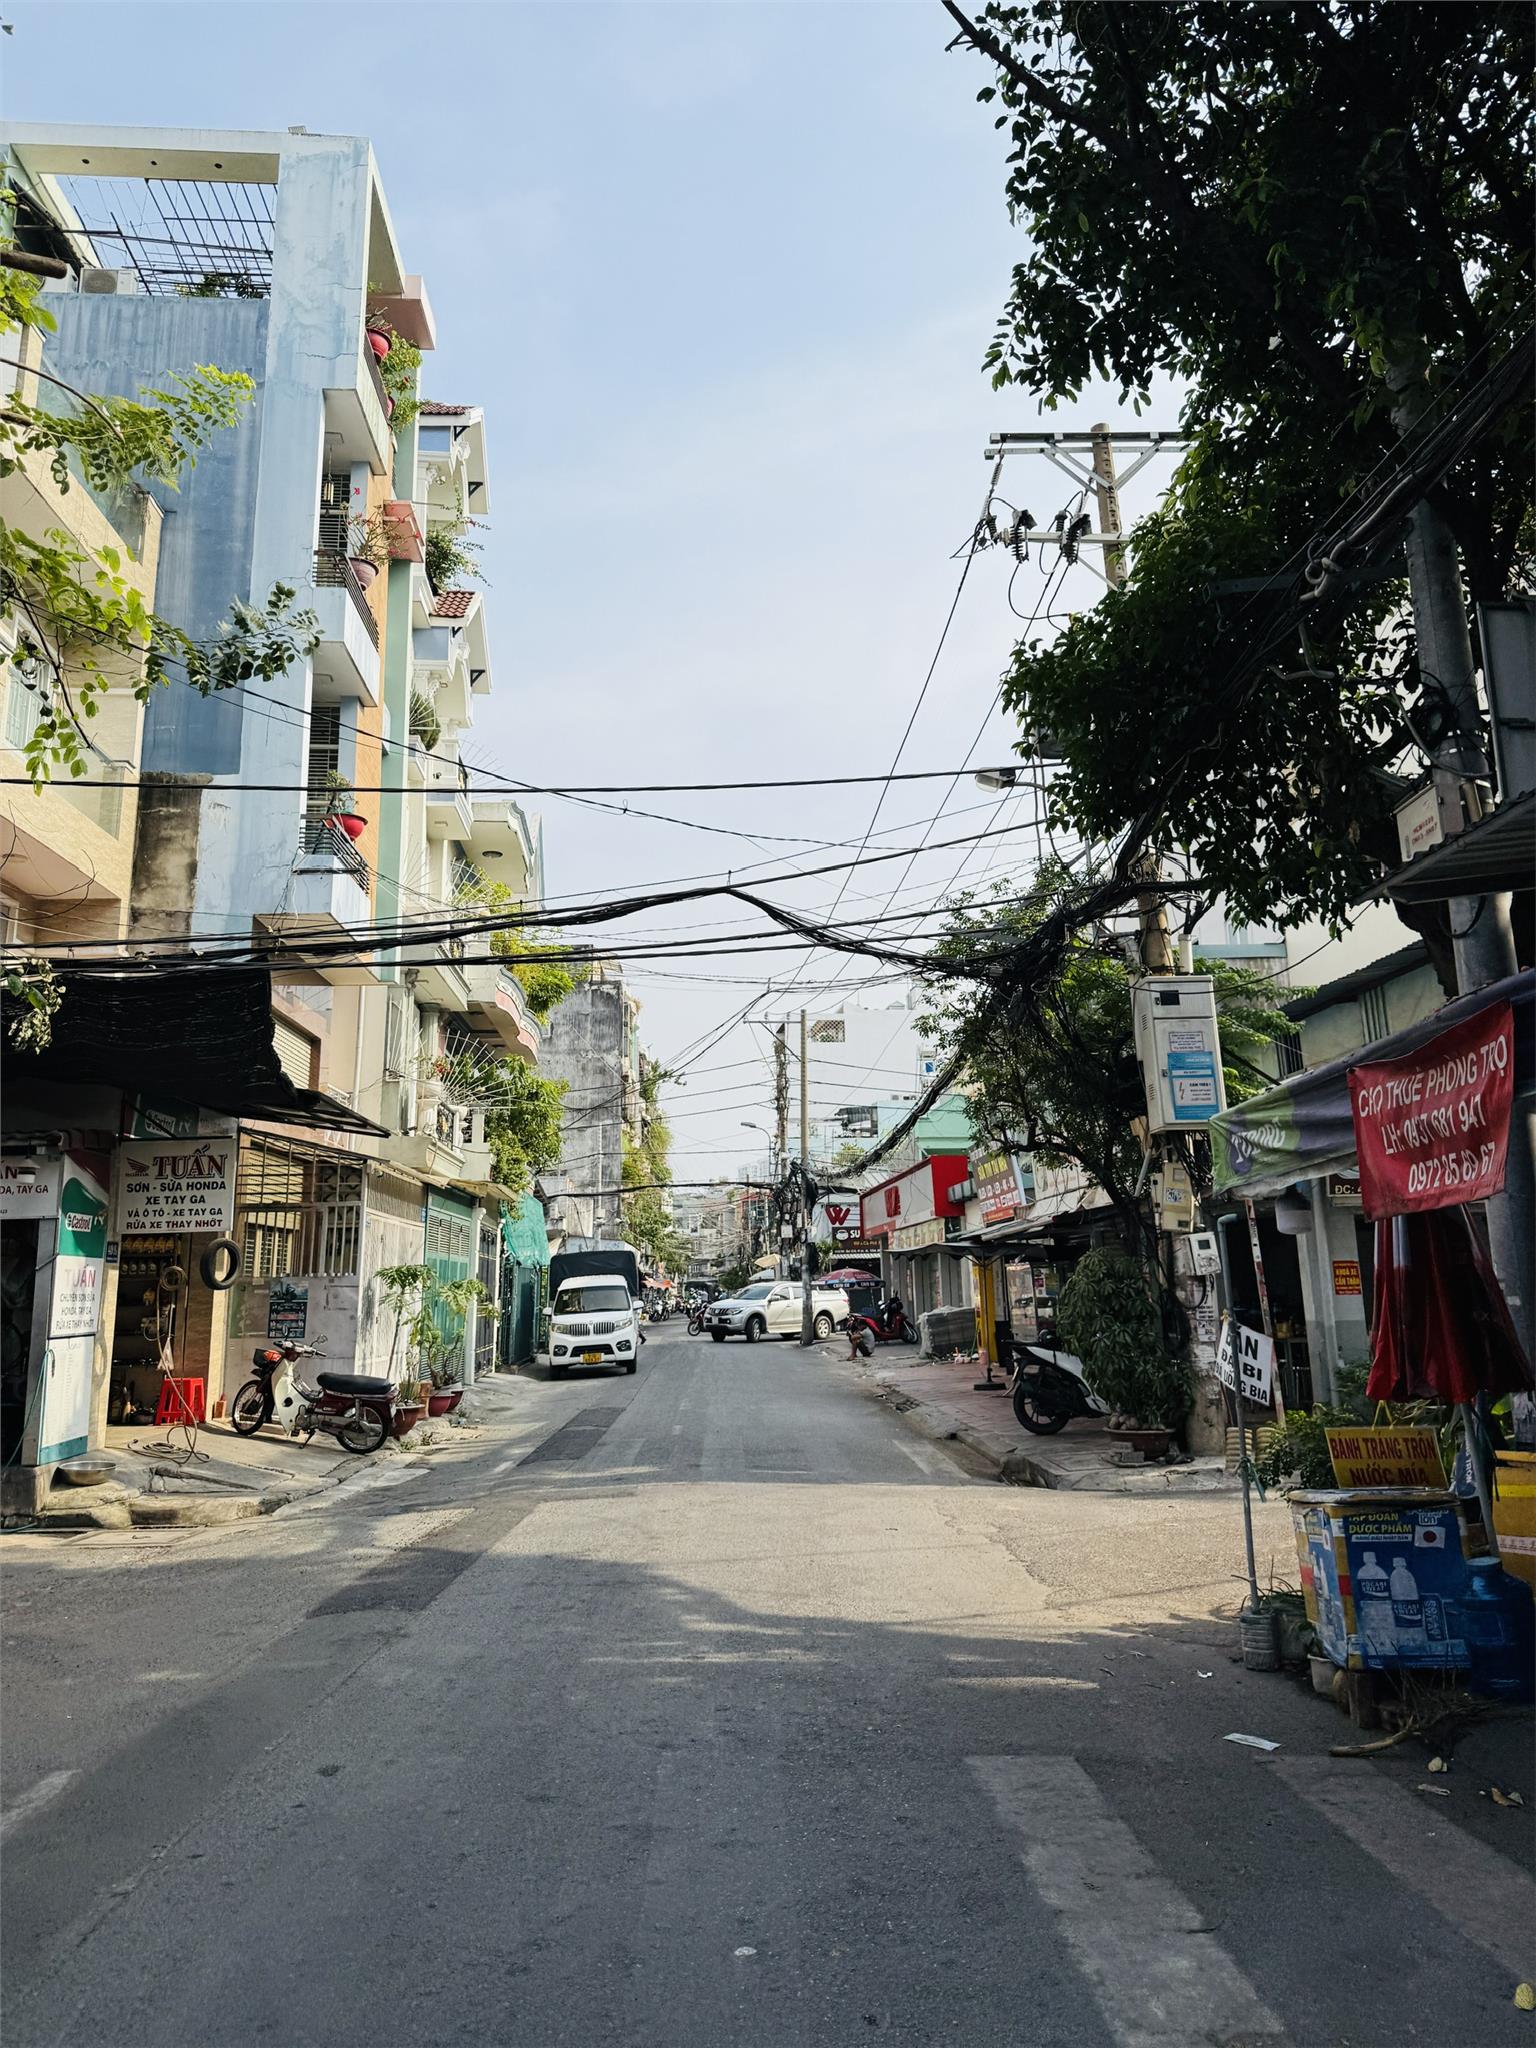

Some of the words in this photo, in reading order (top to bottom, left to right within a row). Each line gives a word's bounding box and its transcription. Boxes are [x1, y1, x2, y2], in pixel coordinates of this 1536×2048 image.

[1426, 1053, 1477, 1098] PHÒNG
[1480, 1035, 1507, 1077] TRỌ
[1381, 1125, 1405, 1155] LH:
[1403, 1114, 1434, 1149] 0937
[1431, 1105, 1457, 1138] 681
[152, 1143, 227, 1180] TUẤN
[1408, 1159, 1440, 1193] 0972
[1442, 1153, 1460, 1184] 85
[1480, 1142, 1496, 1175] 67
[17, 1185, 35, 1194] TAY
[36, 1185, 49, 1194] GA
[126, 1181, 150, 1193] SƠN
[160, 1179, 183, 1192] SỬA
[186, 1181, 226, 1191] HONDA
[145, 1196, 160, 1205] XE
[164, 1196, 186, 1205] TAY
[190, 1195, 206, 1204] GA
[172, 1208, 185, 1217] XE
[188, 1208, 206, 1216] TAY
[209, 1207, 223, 1215] GA
[126, 1219, 146, 1229] RỬA
[149, 1220, 162, 1229] XE
[166, 1220, 192, 1229] THAY
[195, 1218, 223, 1227] NHỚT
[1243, 1362, 1262, 1382] BI
[1249, 1384, 1268, 1402] BIA
[1330, 1431, 1361, 1459] BÁNH
[1362, 1431, 1402, 1459] TRÁNG
[1349, 1462, 1393, 1486] NƯỚC
